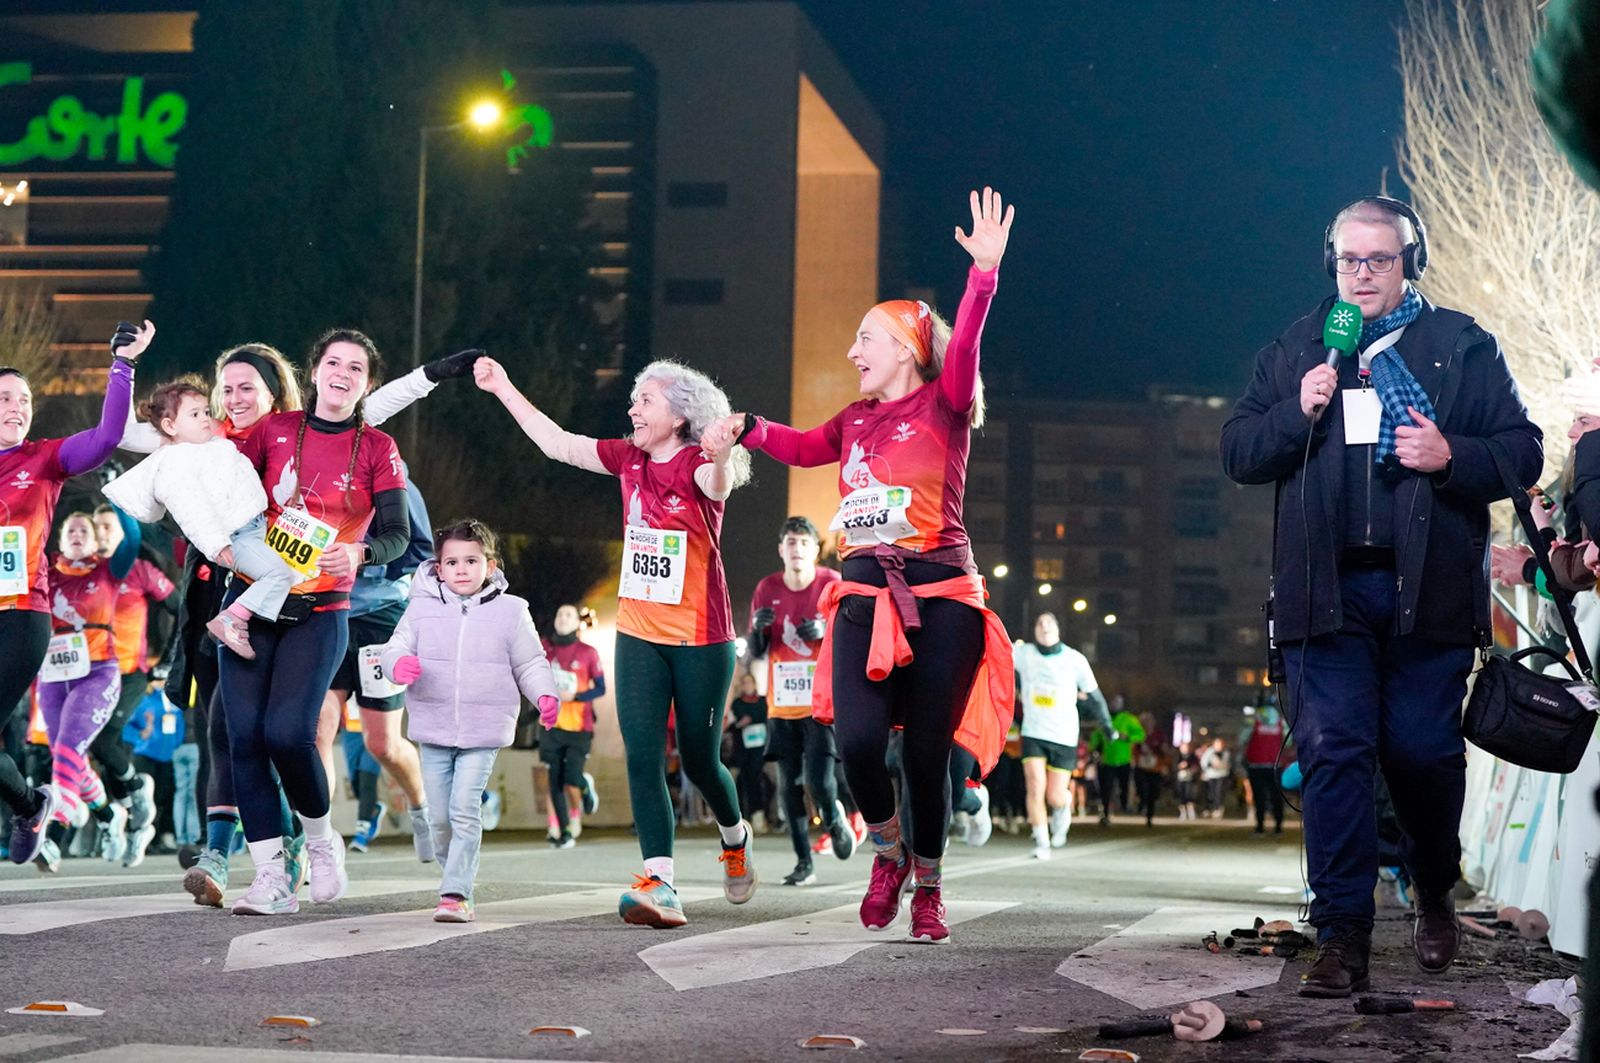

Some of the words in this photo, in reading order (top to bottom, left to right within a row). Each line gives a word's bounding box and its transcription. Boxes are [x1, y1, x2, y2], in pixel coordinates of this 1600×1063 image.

[851, 469, 869, 489] 43
[281, 513, 299, 526] OCHE
[299, 521, 309, 530] DE
[268, 527, 313, 565] 4049
[633, 552, 671, 578] 6353
[50, 650, 80, 666] 4460
[784, 678, 811, 691] 4591
